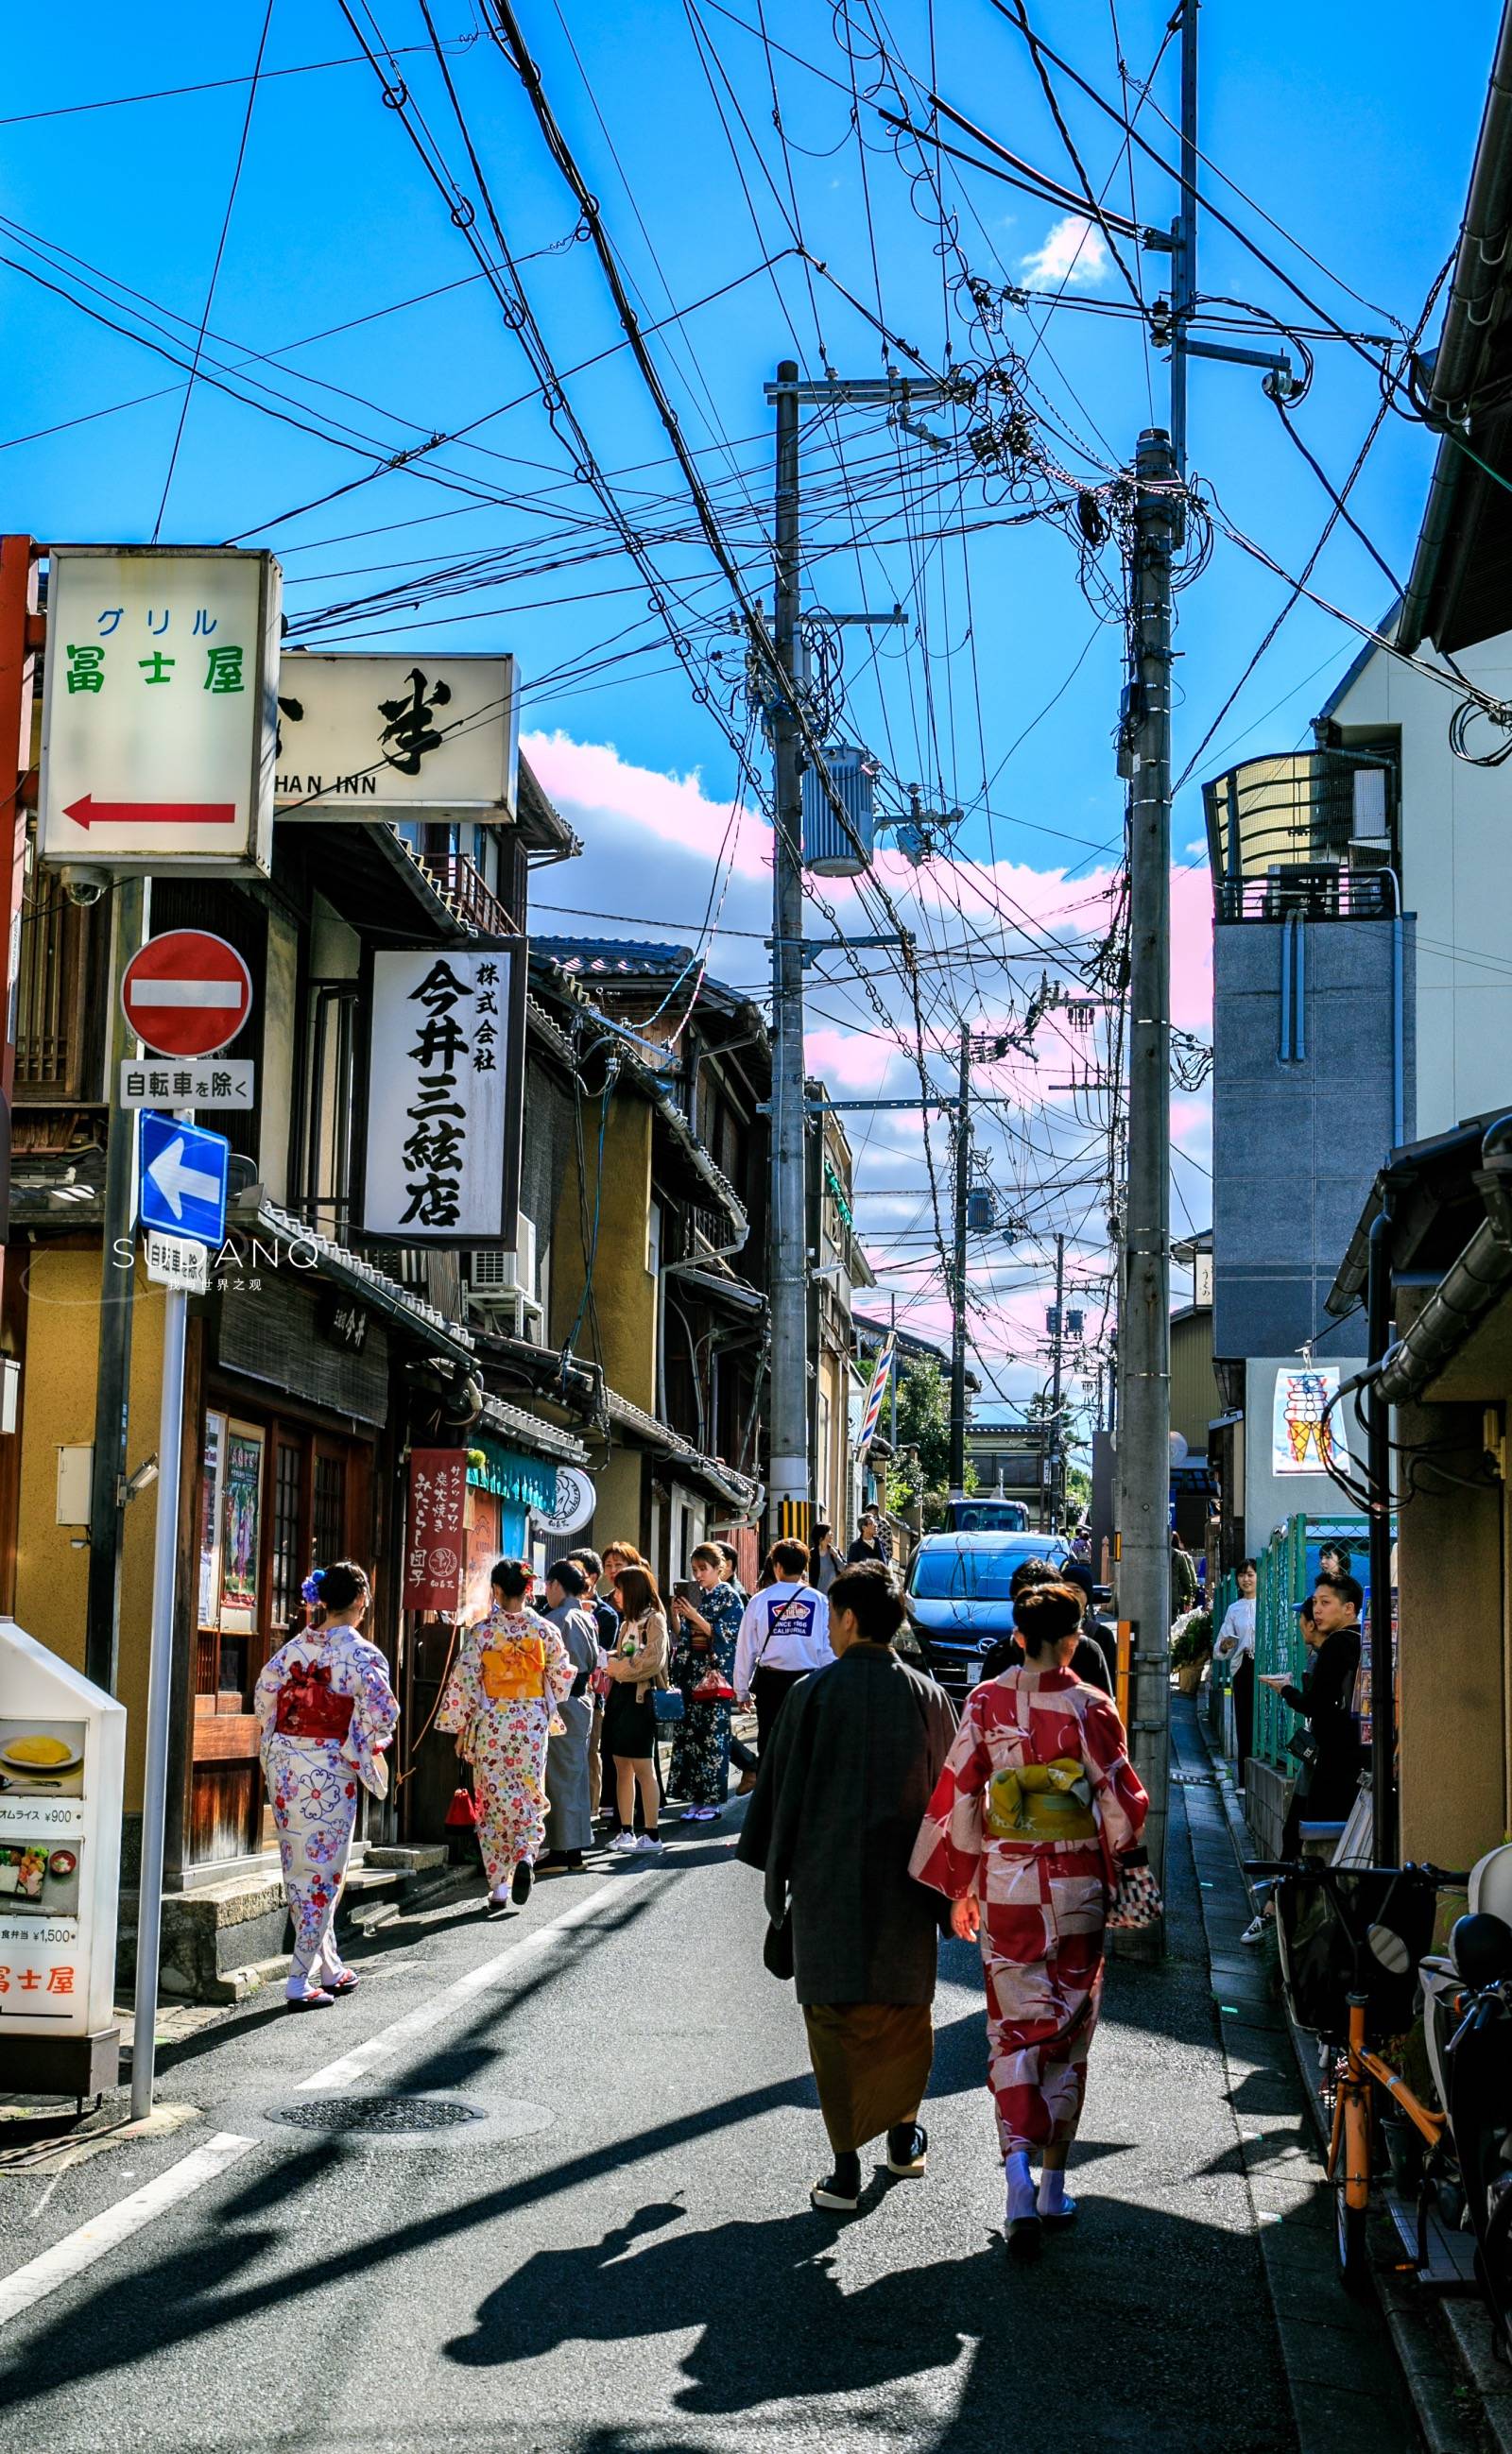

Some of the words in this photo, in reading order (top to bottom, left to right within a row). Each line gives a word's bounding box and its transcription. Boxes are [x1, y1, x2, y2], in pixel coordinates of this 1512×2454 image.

[98, 608, 217, 636] グリル
[336, 776, 376, 795] INN
[472, 962, 500, 1073] 株式会社
[127, 1071, 248, 1097] 自転車を除く
[398, 959, 474, 1227] 今井三絃店
[432, 1471, 449, 1534] 炭火焼き
[408, 1472, 433, 1588] みたらし団子
[0, 1810, 40, 1821] オムライス
[44, 1810, 72, 1823] ¥900
[1, 1930, 29, 1940] 食弁当
[33, 1930, 70, 1943] ¥1,500
